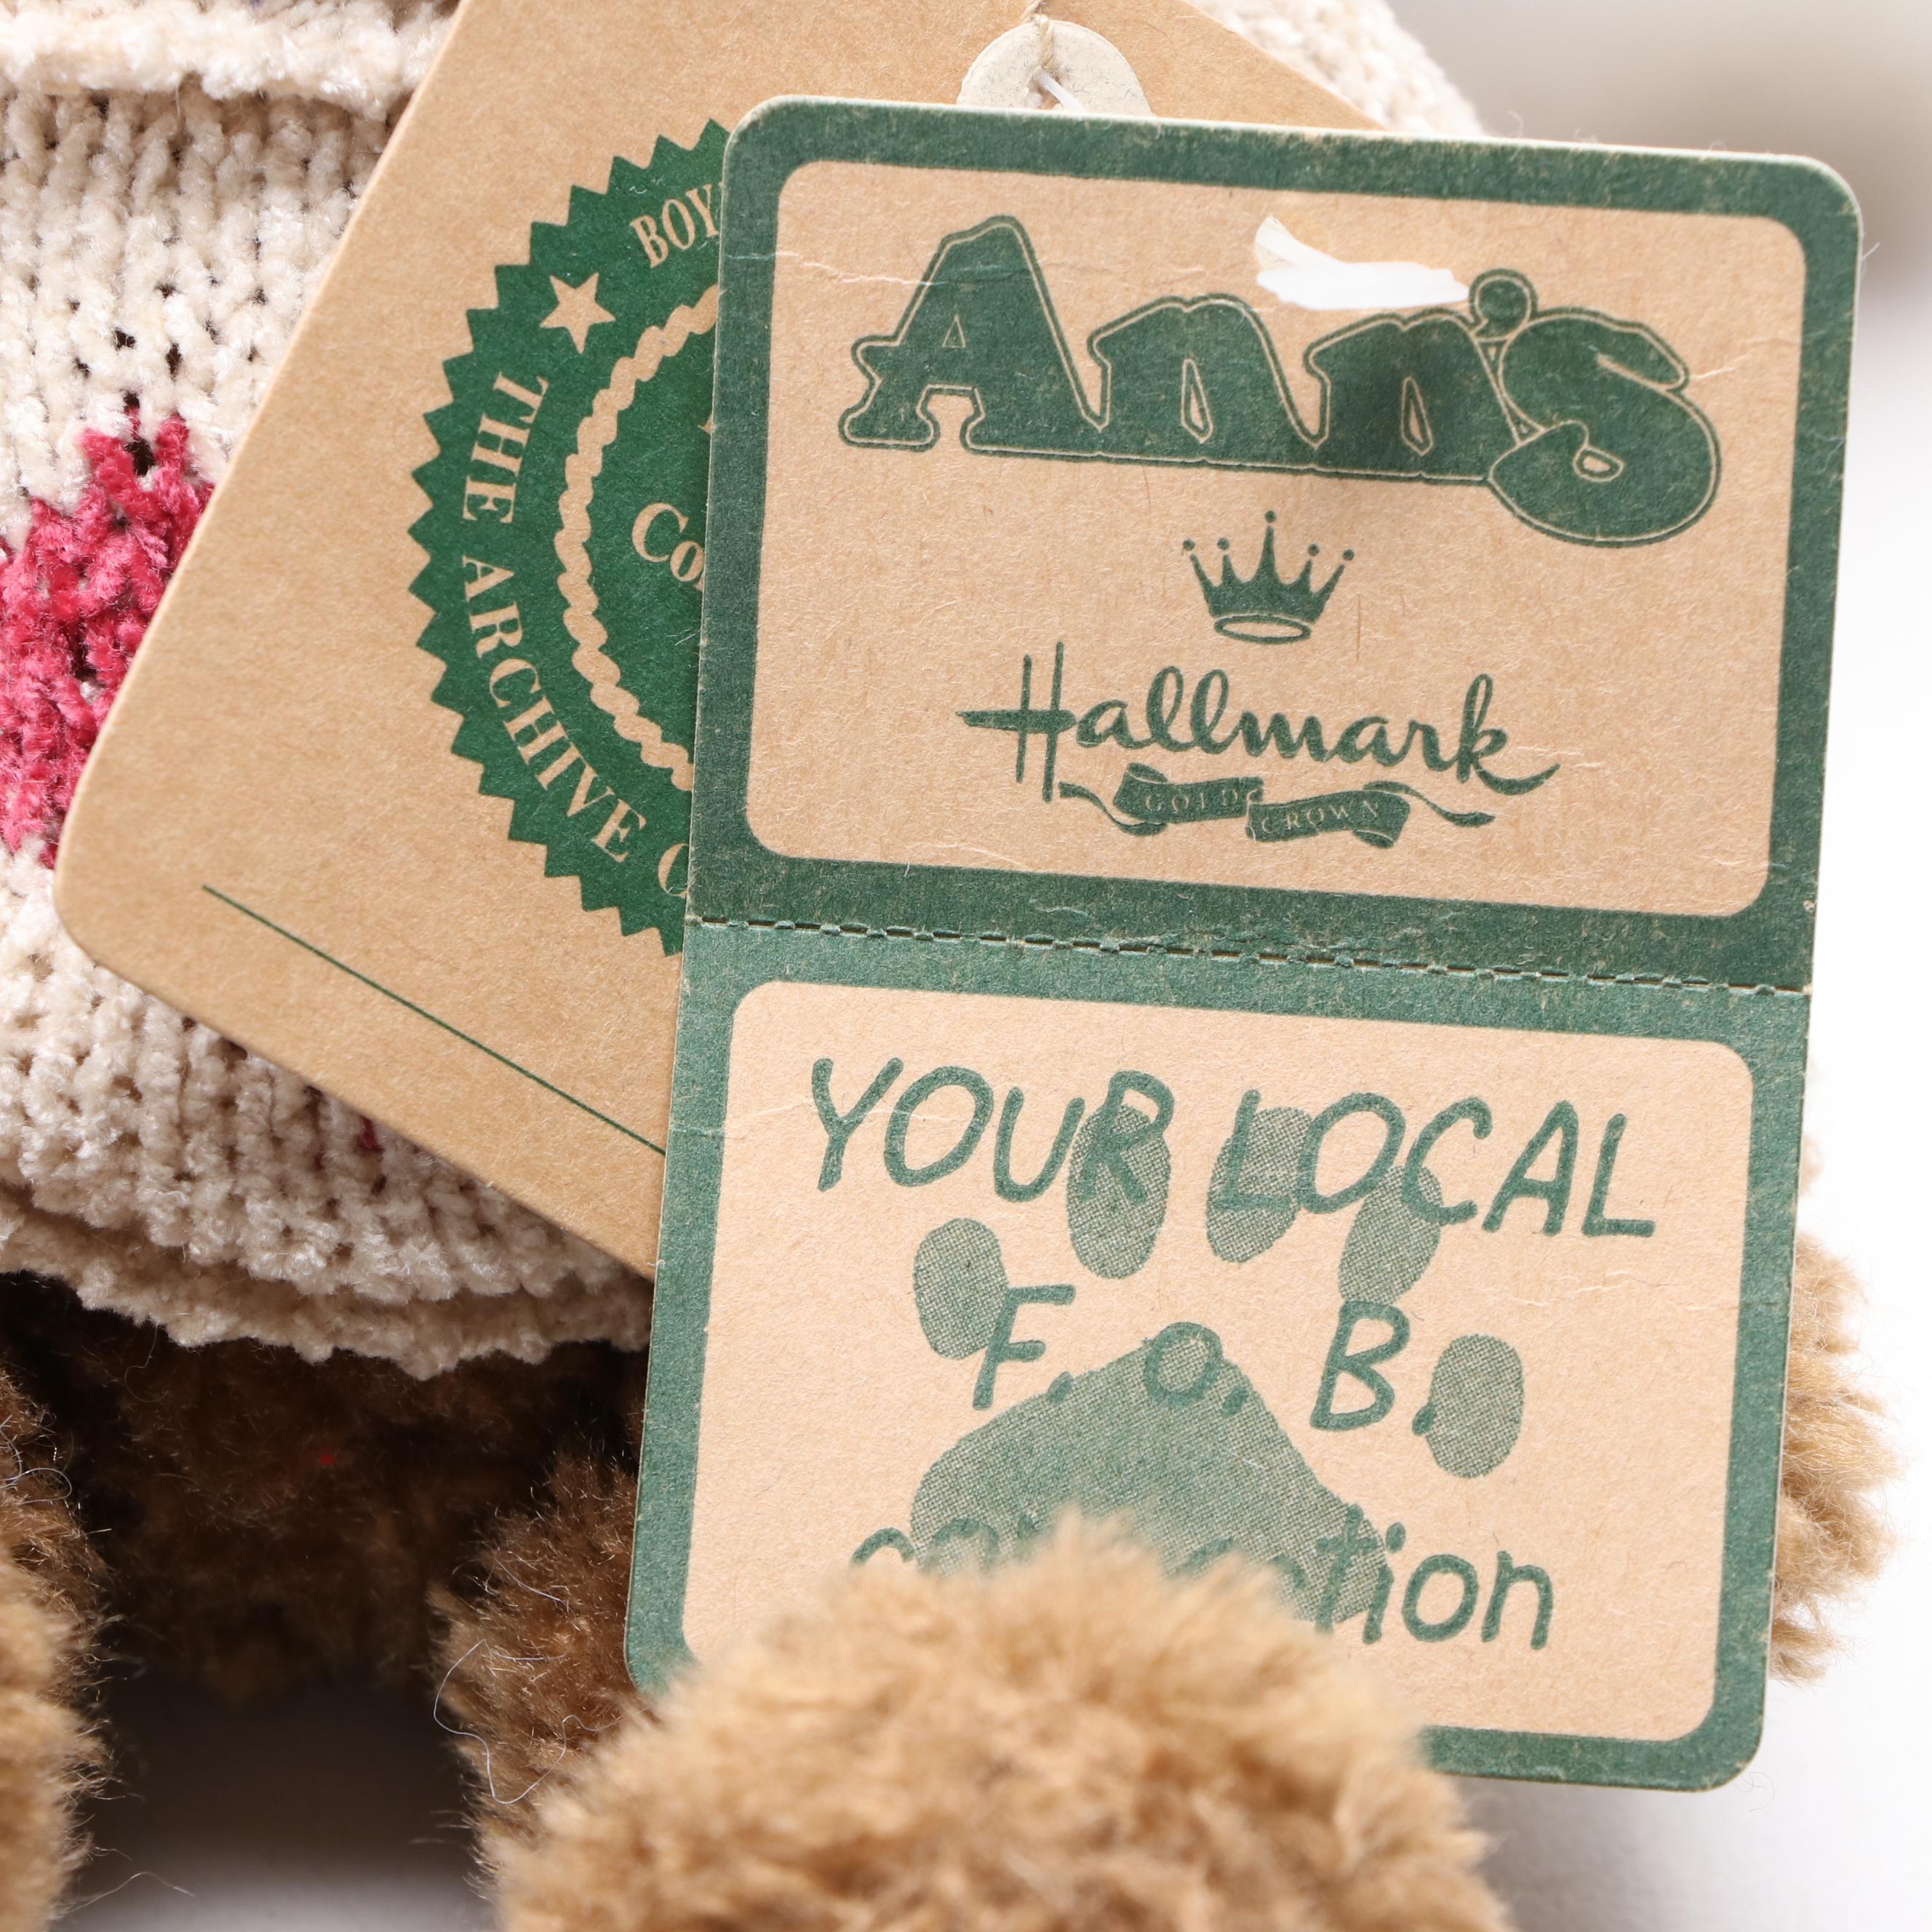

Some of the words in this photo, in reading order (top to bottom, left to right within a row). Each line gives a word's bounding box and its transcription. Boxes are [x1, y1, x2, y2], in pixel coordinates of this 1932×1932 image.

[629, 180, 725, 268] BOY
[460, 372, 548, 524] THE
[839, 215, 1721, 546] Ann's
[462, 555, 647, 863] ARCHIVE
[956, 642, 1560, 802] Hallmark
[1261, 800, 1380, 834] CROWN
[811, 1057, 1174, 1203] YOUR
[1213, 1089, 1655, 1237] LOCAL
